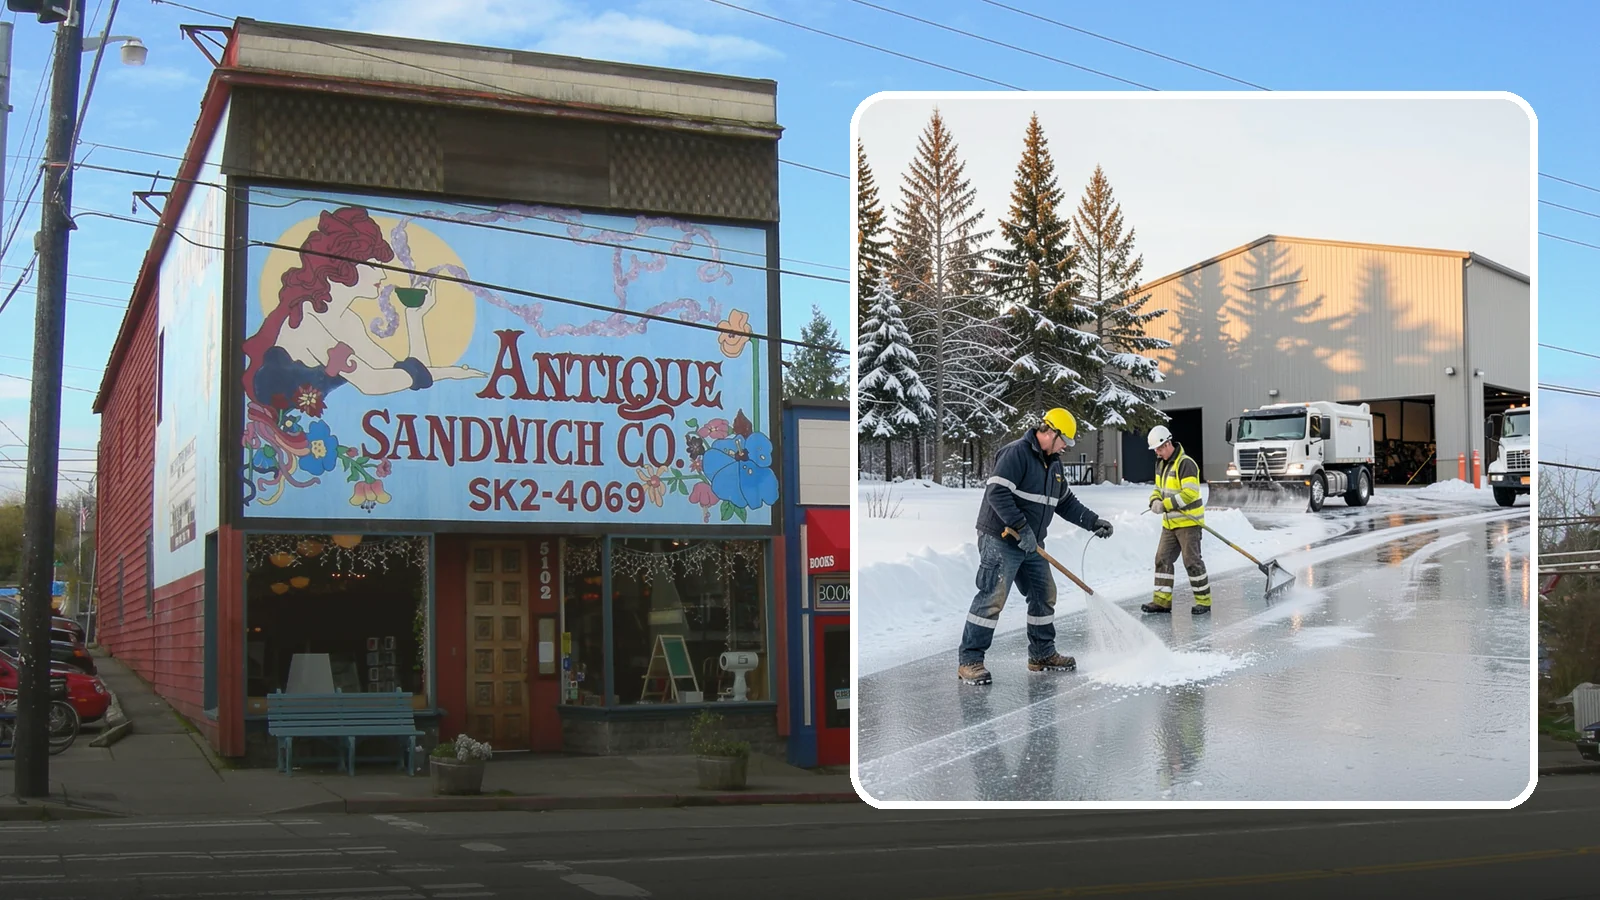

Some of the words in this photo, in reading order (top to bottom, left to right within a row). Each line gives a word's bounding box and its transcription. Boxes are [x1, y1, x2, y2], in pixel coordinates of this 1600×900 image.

[476, 329, 723, 421] ANTIQUE
[361, 408, 604, 467] SANDWICH
[617, 422, 684, 469] CO.
[468, 477, 646, 513] SK2-4069
[540, 541, 552, 600] 5102
[809, 555, 835, 569] BOOKS
